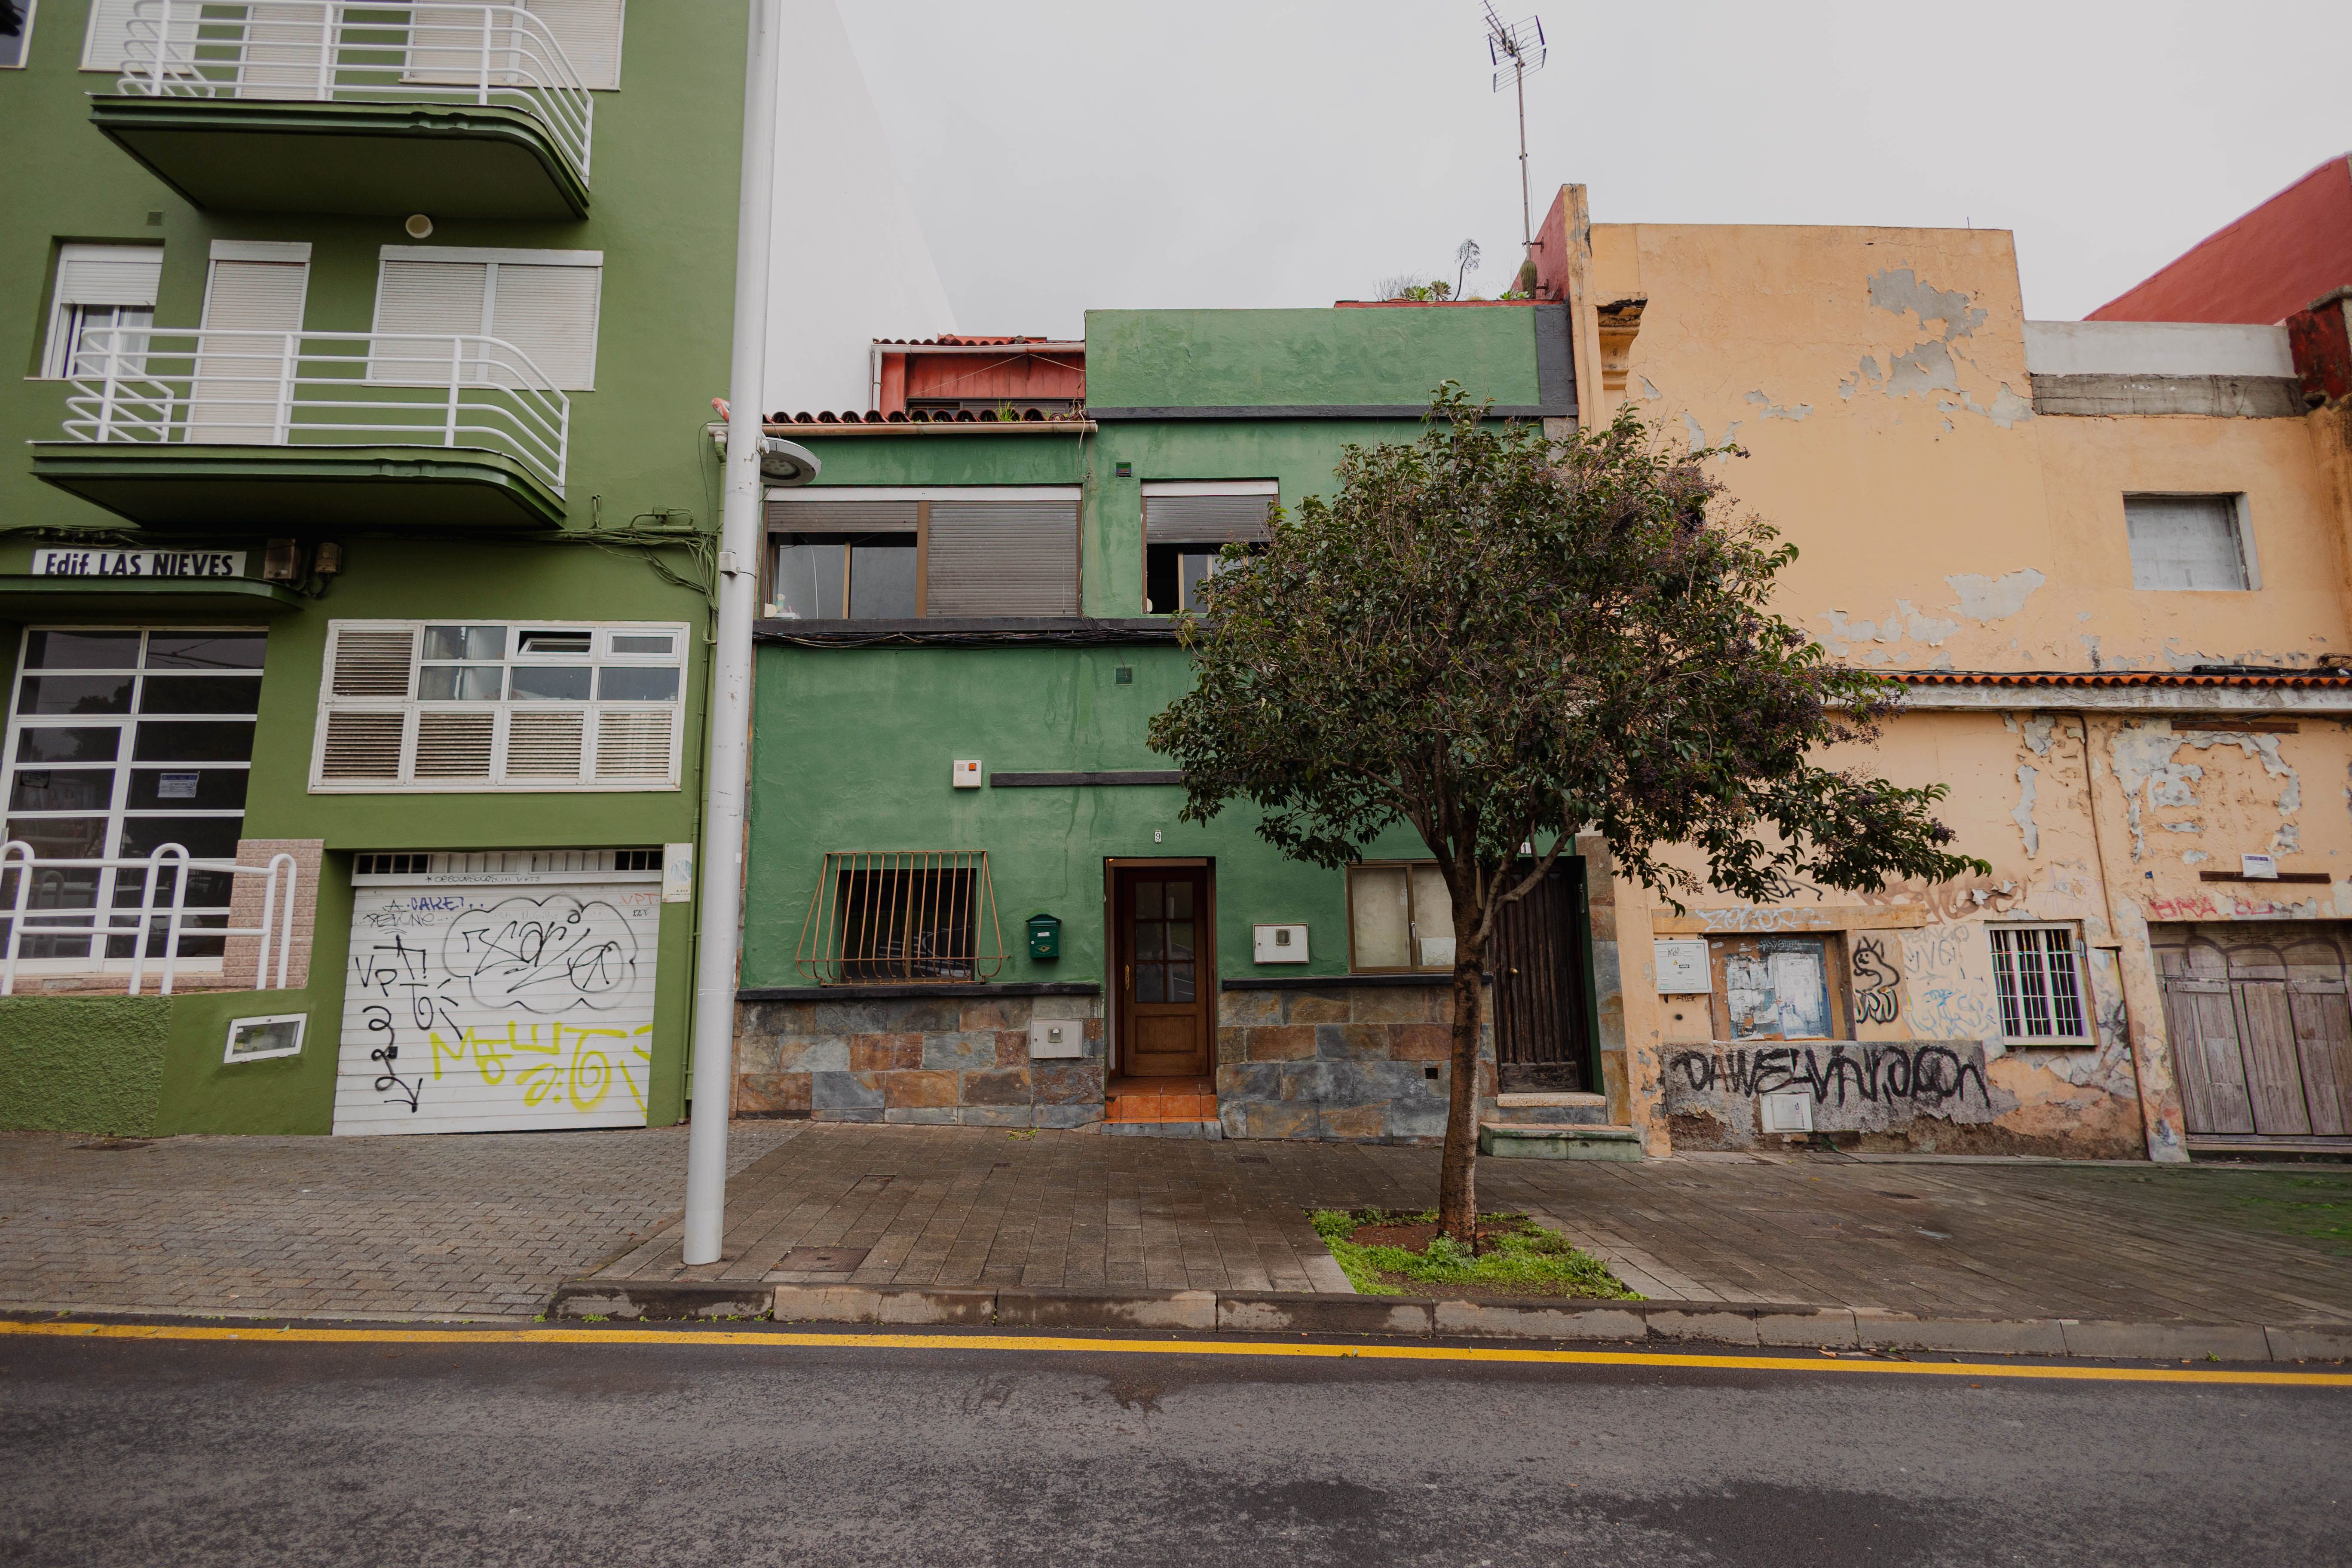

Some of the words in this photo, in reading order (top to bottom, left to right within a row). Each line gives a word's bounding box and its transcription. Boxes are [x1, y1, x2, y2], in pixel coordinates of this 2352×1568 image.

[45, 553, 90, 575] Edif.
[98, 554, 142, 576] LAS
[152, 554, 233, 576] NIEVES
